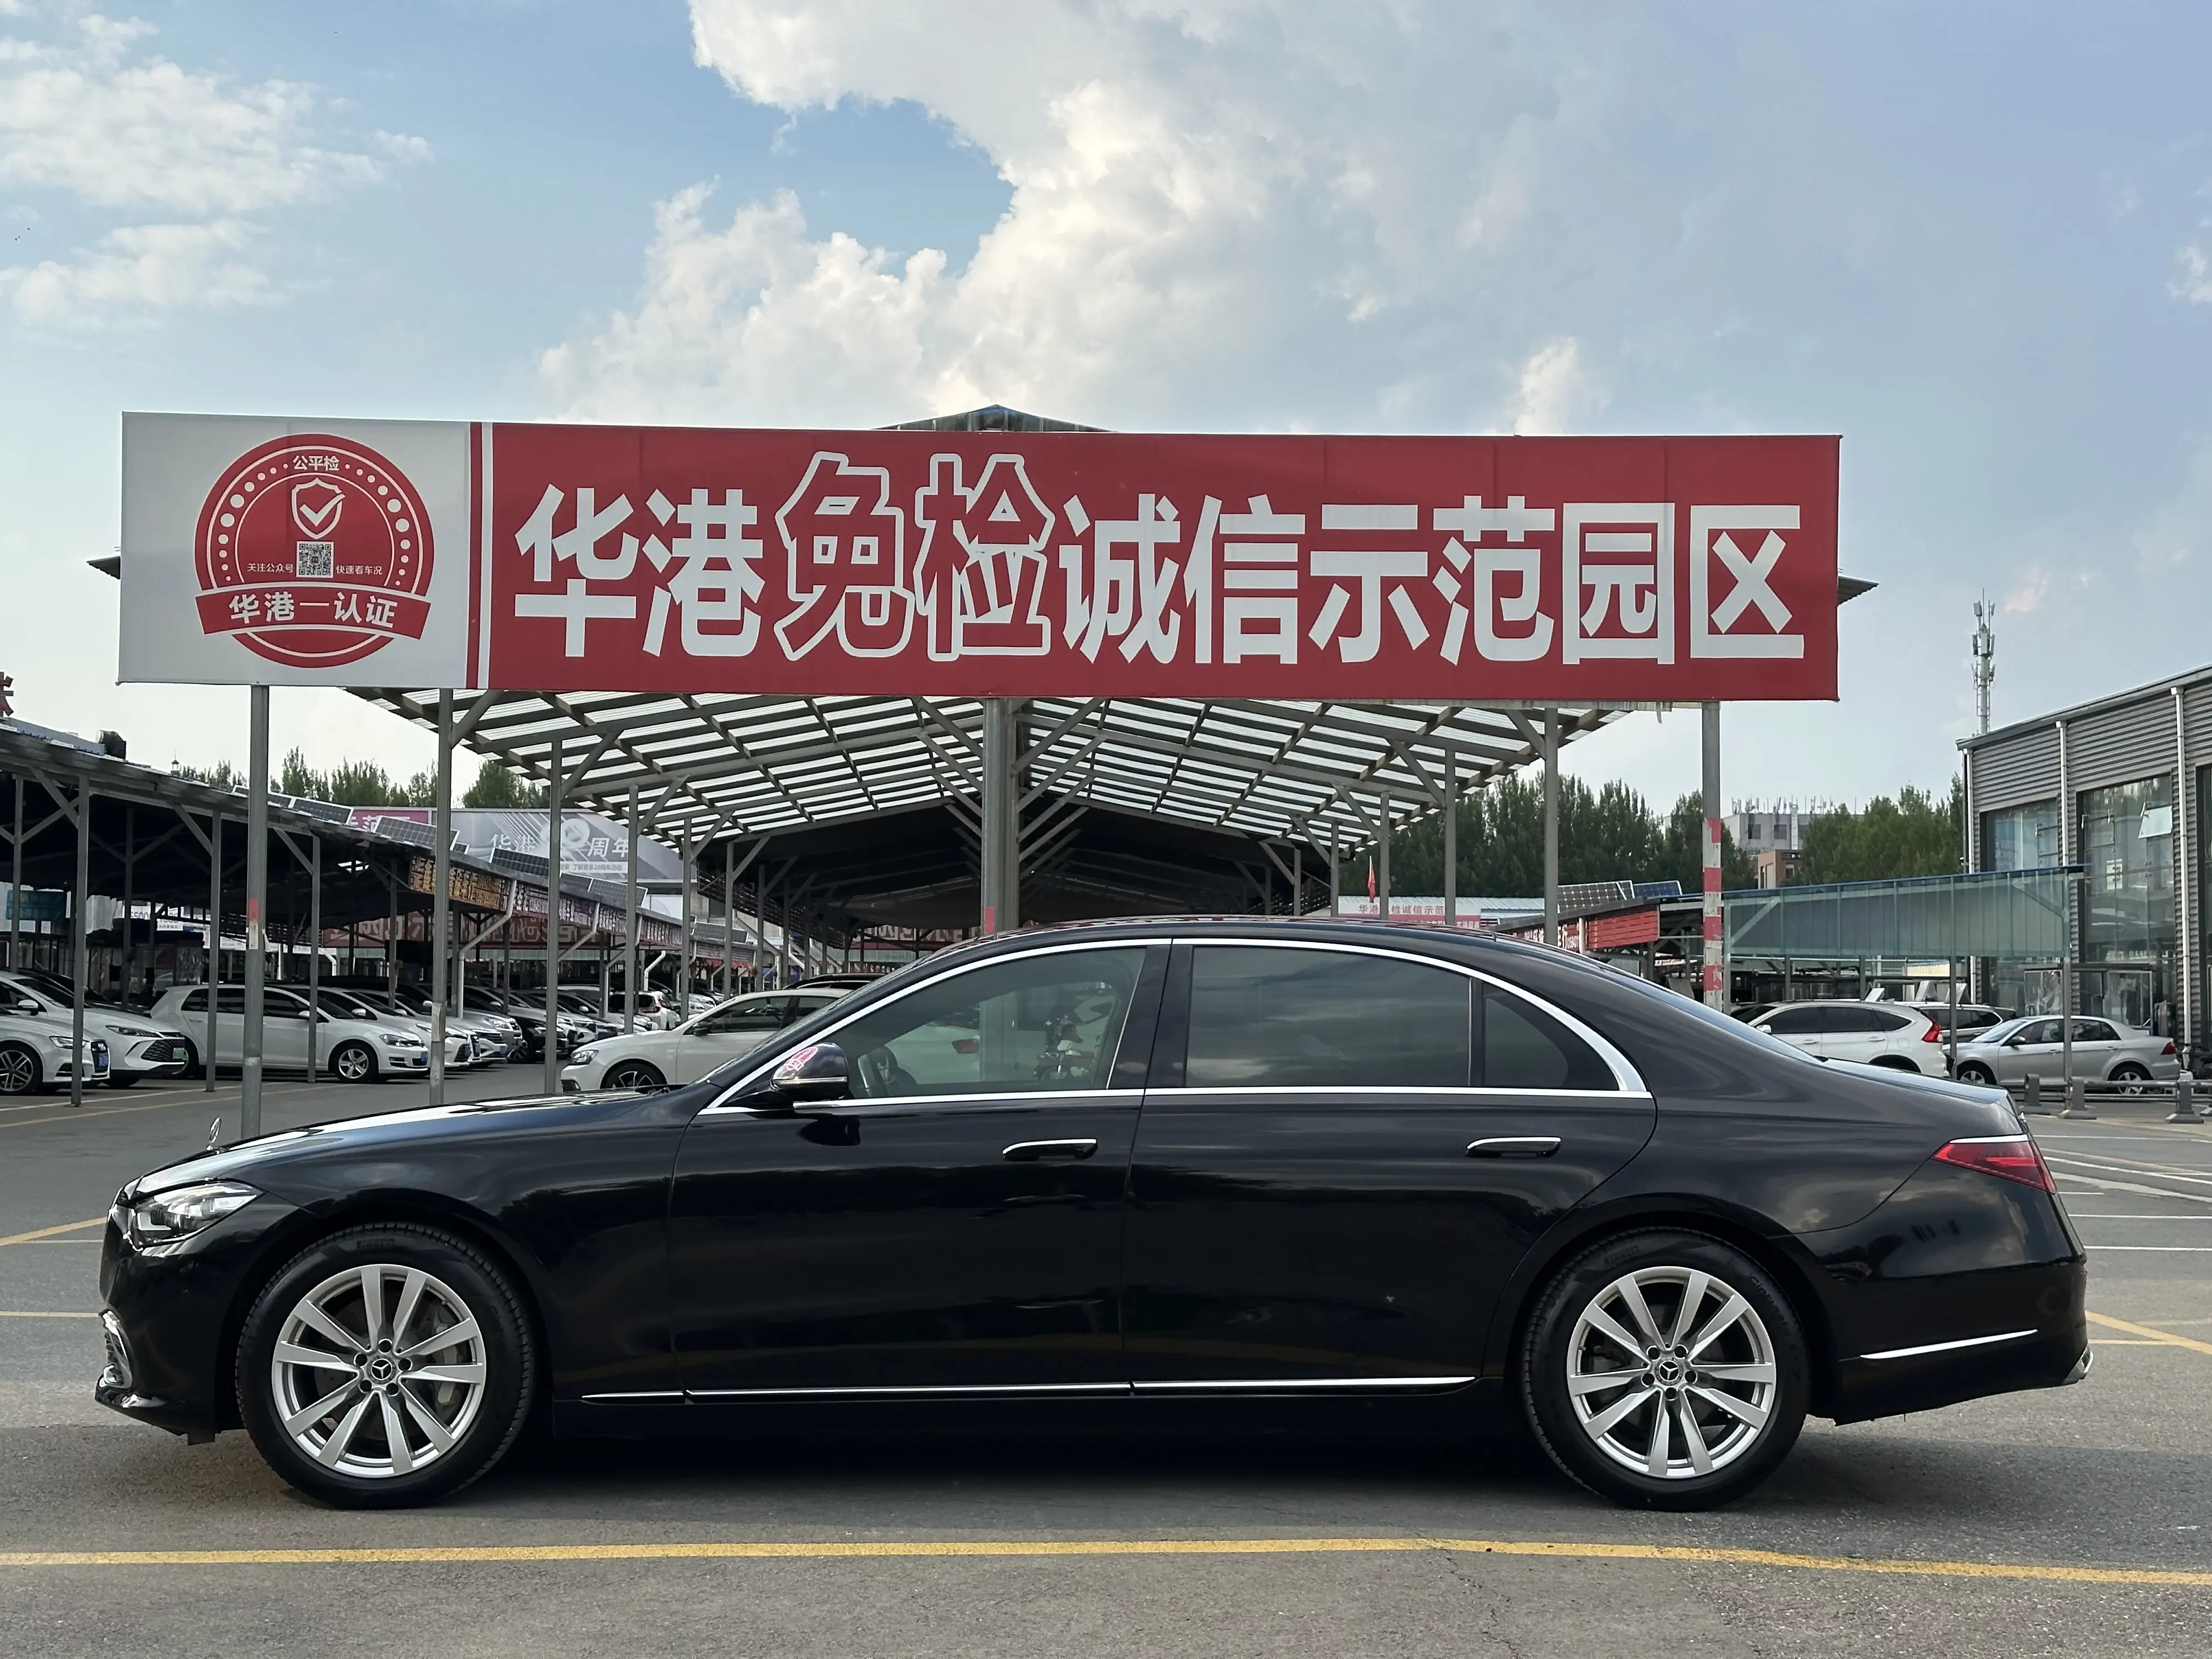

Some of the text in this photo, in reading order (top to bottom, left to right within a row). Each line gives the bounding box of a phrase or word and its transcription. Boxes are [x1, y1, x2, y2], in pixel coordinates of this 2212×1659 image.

[292, 455, 340, 472] 公平检
[514, 451, 1805, 666] 华港免检诚信示范园区
[247, 562, 294, 573] 关注公众号
[335, 564, 383, 575] 快速看车况
[228, 591, 398, 629] 华港一认证
